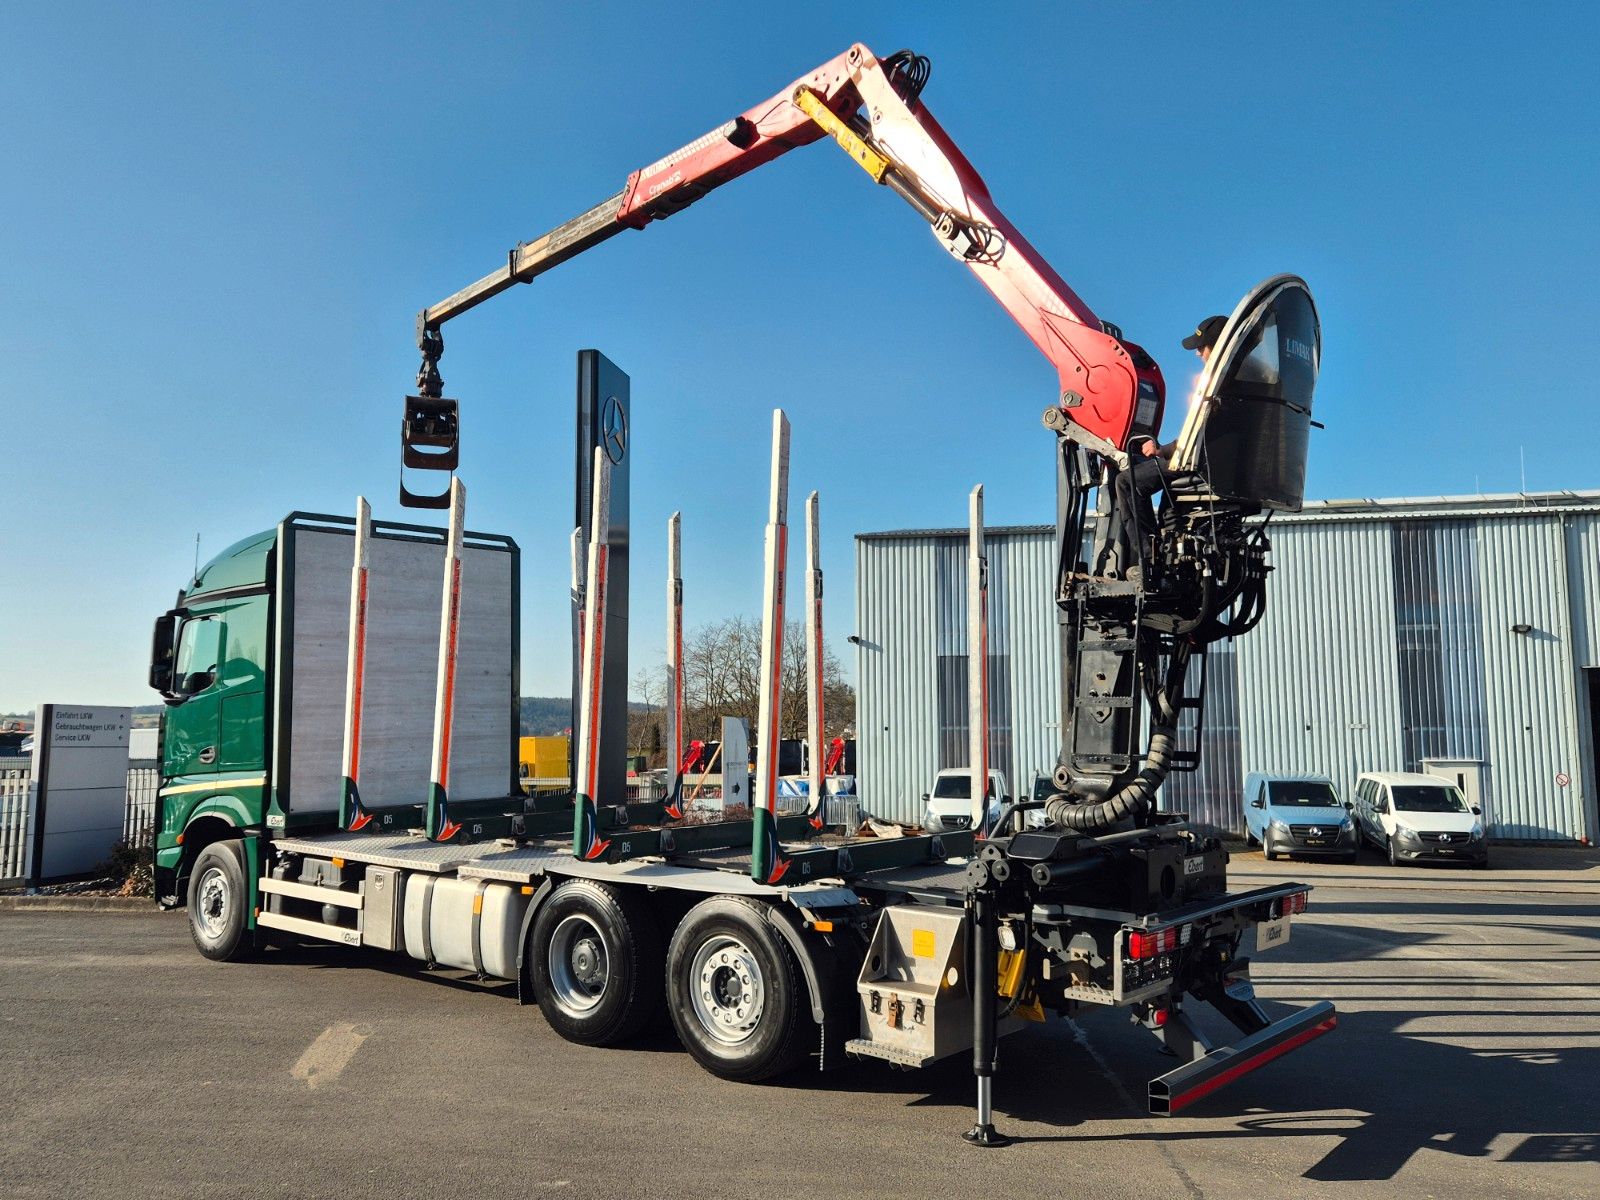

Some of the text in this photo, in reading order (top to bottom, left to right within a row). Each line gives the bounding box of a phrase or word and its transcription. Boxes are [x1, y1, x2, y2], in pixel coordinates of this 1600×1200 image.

[56, 711, 93, 720] Einfahrt LKW
[55, 722, 102, 731] Gebrauchtwagen
[55, 733, 76, 741] Service
